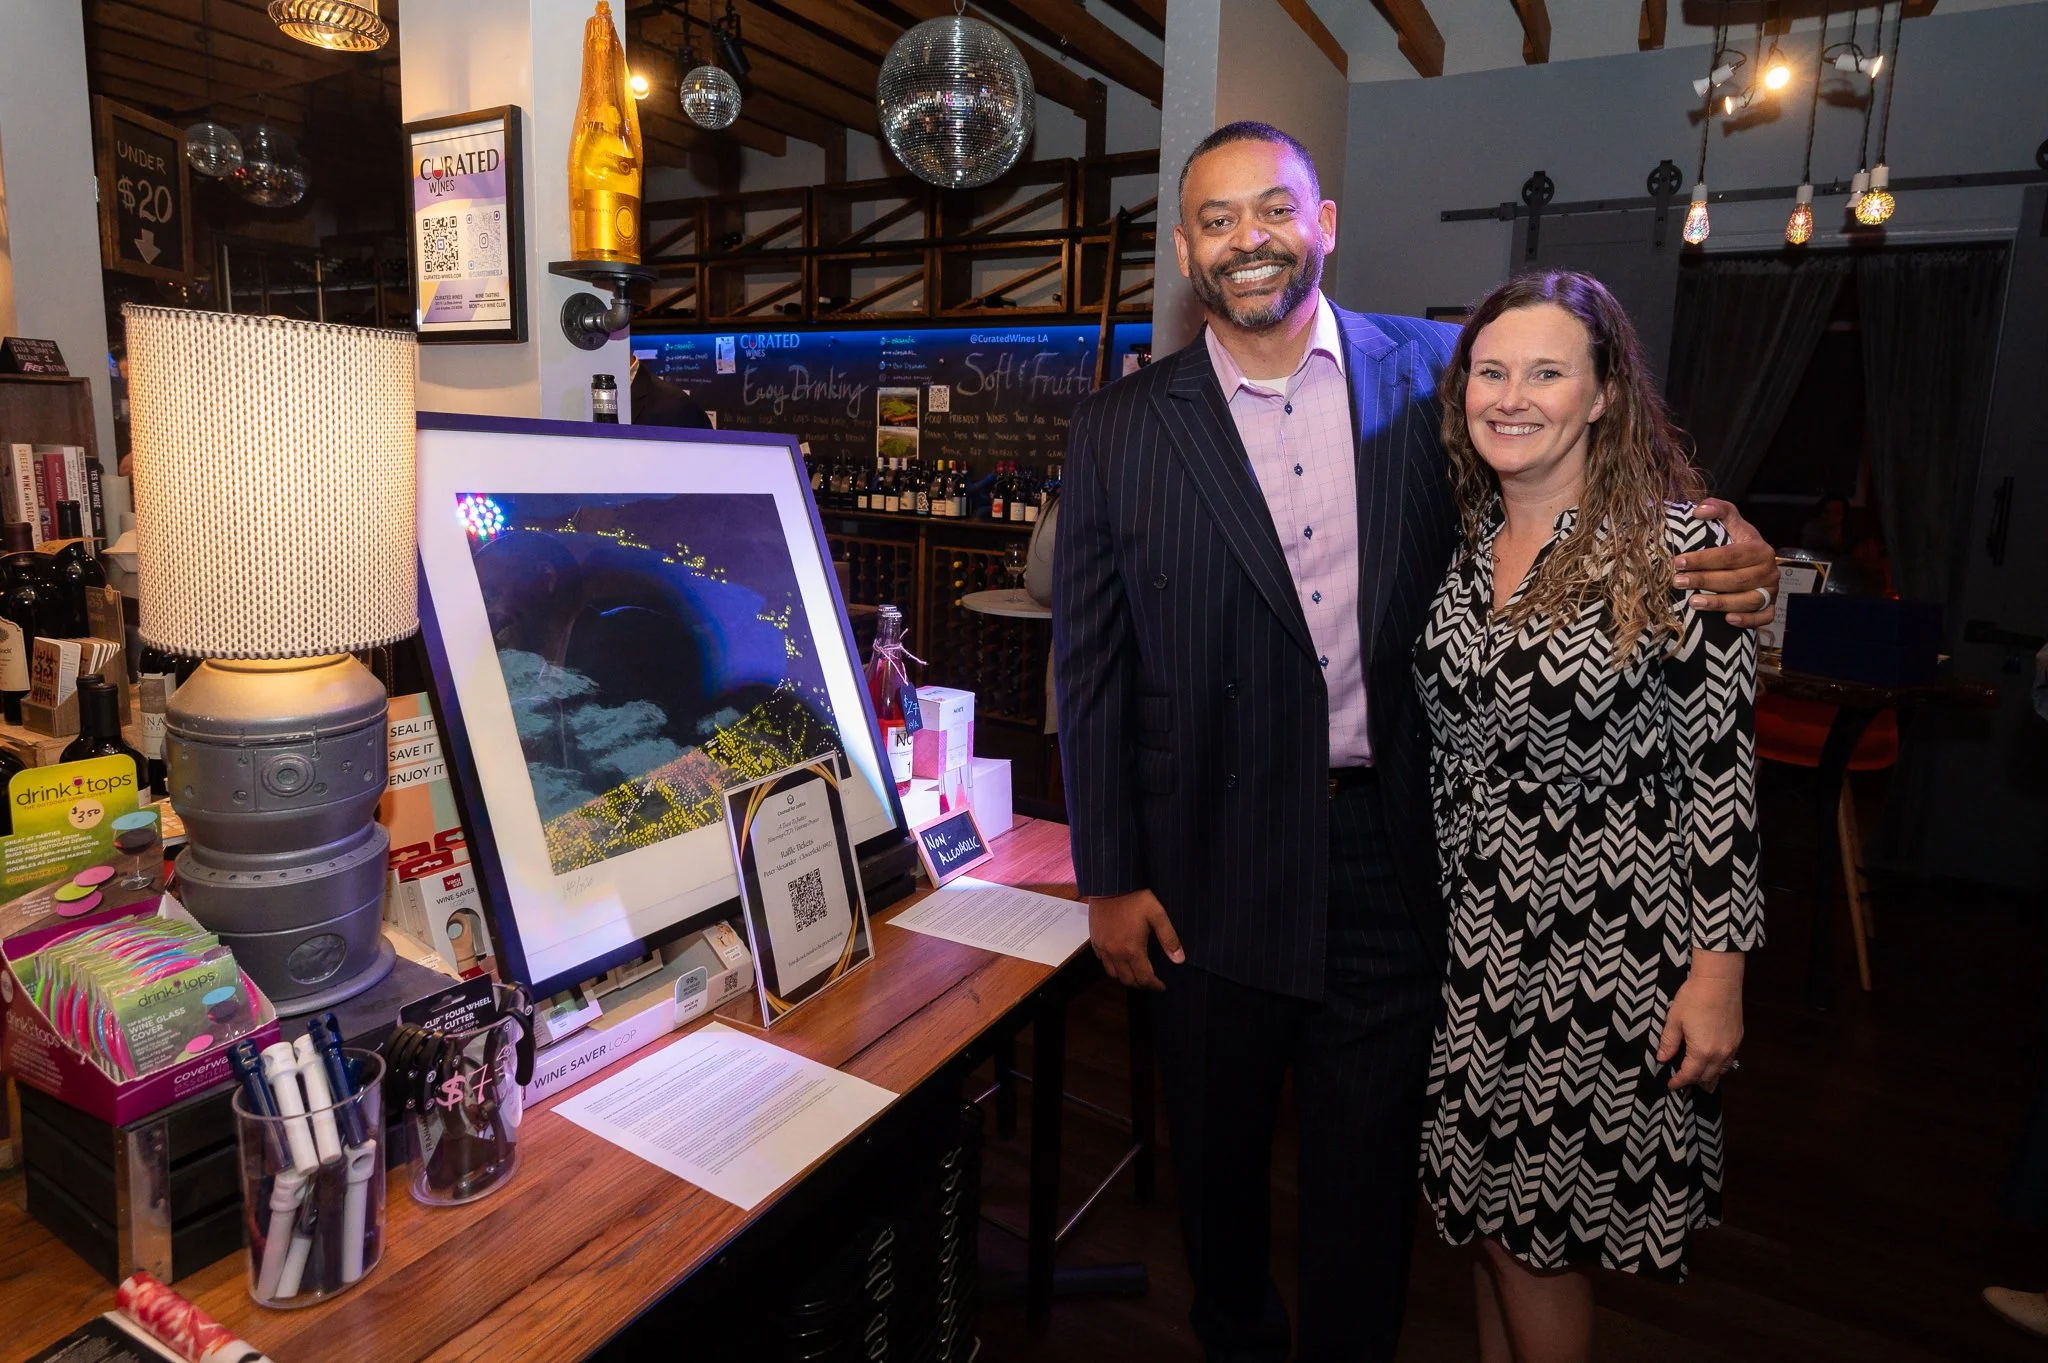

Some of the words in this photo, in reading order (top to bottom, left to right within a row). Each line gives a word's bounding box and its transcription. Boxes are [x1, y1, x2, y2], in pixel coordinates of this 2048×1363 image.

[117, 140, 167, 175] UNDER
[420, 149, 499, 180] CURATED
[118, 176, 173, 223] $20
[429, 180, 455, 195] WINES
[740, 334, 800, 349] CURATED
[970, 334, 1035, 344] @CuratedWines
[1037, 334, 1049, 343] LA
[746, 349, 766, 359] WINES
[743, 364, 790, 415] Easy
[788, 364, 868, 418] Drinking
[956, 352, 1015, 409] Soft
[19, 448, 28, 472] CHEESE
[22, 475, 31, 491] WINE
[25, 502, 35, 522] BREAD
[390, 723, 420, 738] SEAL
[423, 719, 434, 731] IT
[389, 746, 420, 762] SAVE
[423, 742, 434, 754] IT
[389, 766, 430, 786] ENJOY
[434, 763, 444, 775] IT
[16, 782, 72, 806] drink
[86, 773, 132, 793] tops
[796, 839, 814, 851] Tickets
[938, 836, 980, 865] ALCOHOLIC
[436, 893, 455, 904] WINE
[455, 887, 475, 899] SAVER
[138, 987, 174, 1008] drink
[183, 971, 216, 990] tops
[129, 1019, 155, 1034] WINE
[156, 1007, 186, 1023] GLASS
[444, 1012, 475, 1030] CUTTER
[445, 1009, 466, 1021] FOUR
[467, 997, 492, 1012] WHEEL
[35, 1024, 61, 1048] tops
[131, 1024, 164, 1041] COVER
[174, 1056, 229, 1084] coverwa
[534, 1066, 568, 1089] WINE
[570, 1045, 607, 1071] SAVER
[608, 1030, 637, 1052] LOOP
[436, 1064, 493, 1111] $7
